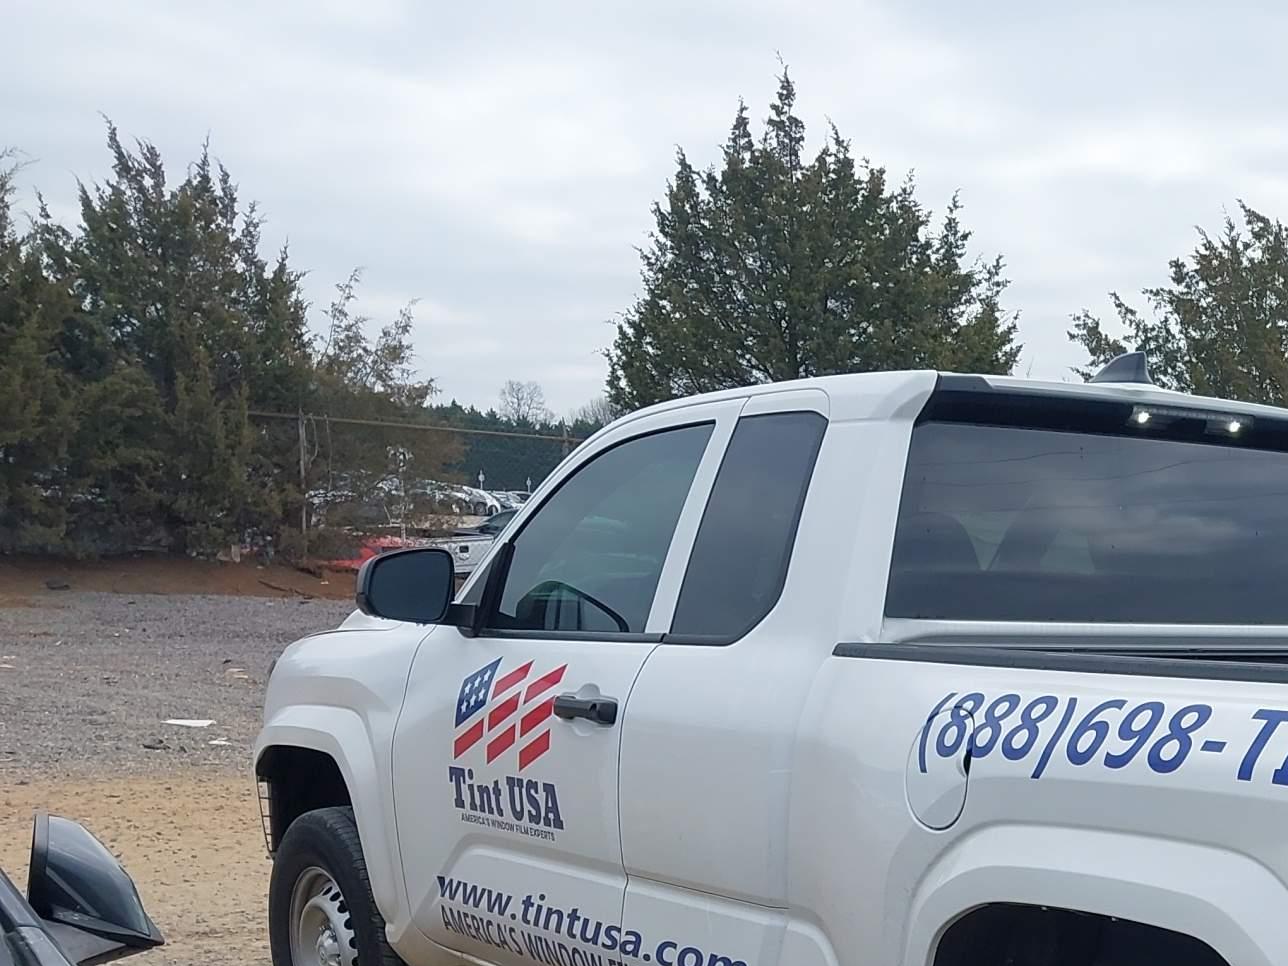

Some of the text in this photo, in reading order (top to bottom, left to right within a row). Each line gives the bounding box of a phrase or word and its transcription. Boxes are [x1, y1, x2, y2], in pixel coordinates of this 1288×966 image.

[449, 766, 564, 830] Tint USA
[491, 819, 515, 833] WINDOW
[516, 823, 529, 836] FILM
[530, 827, 555, 841] EXPERTS
[440, 904, 523, 956] AMERICA'S
